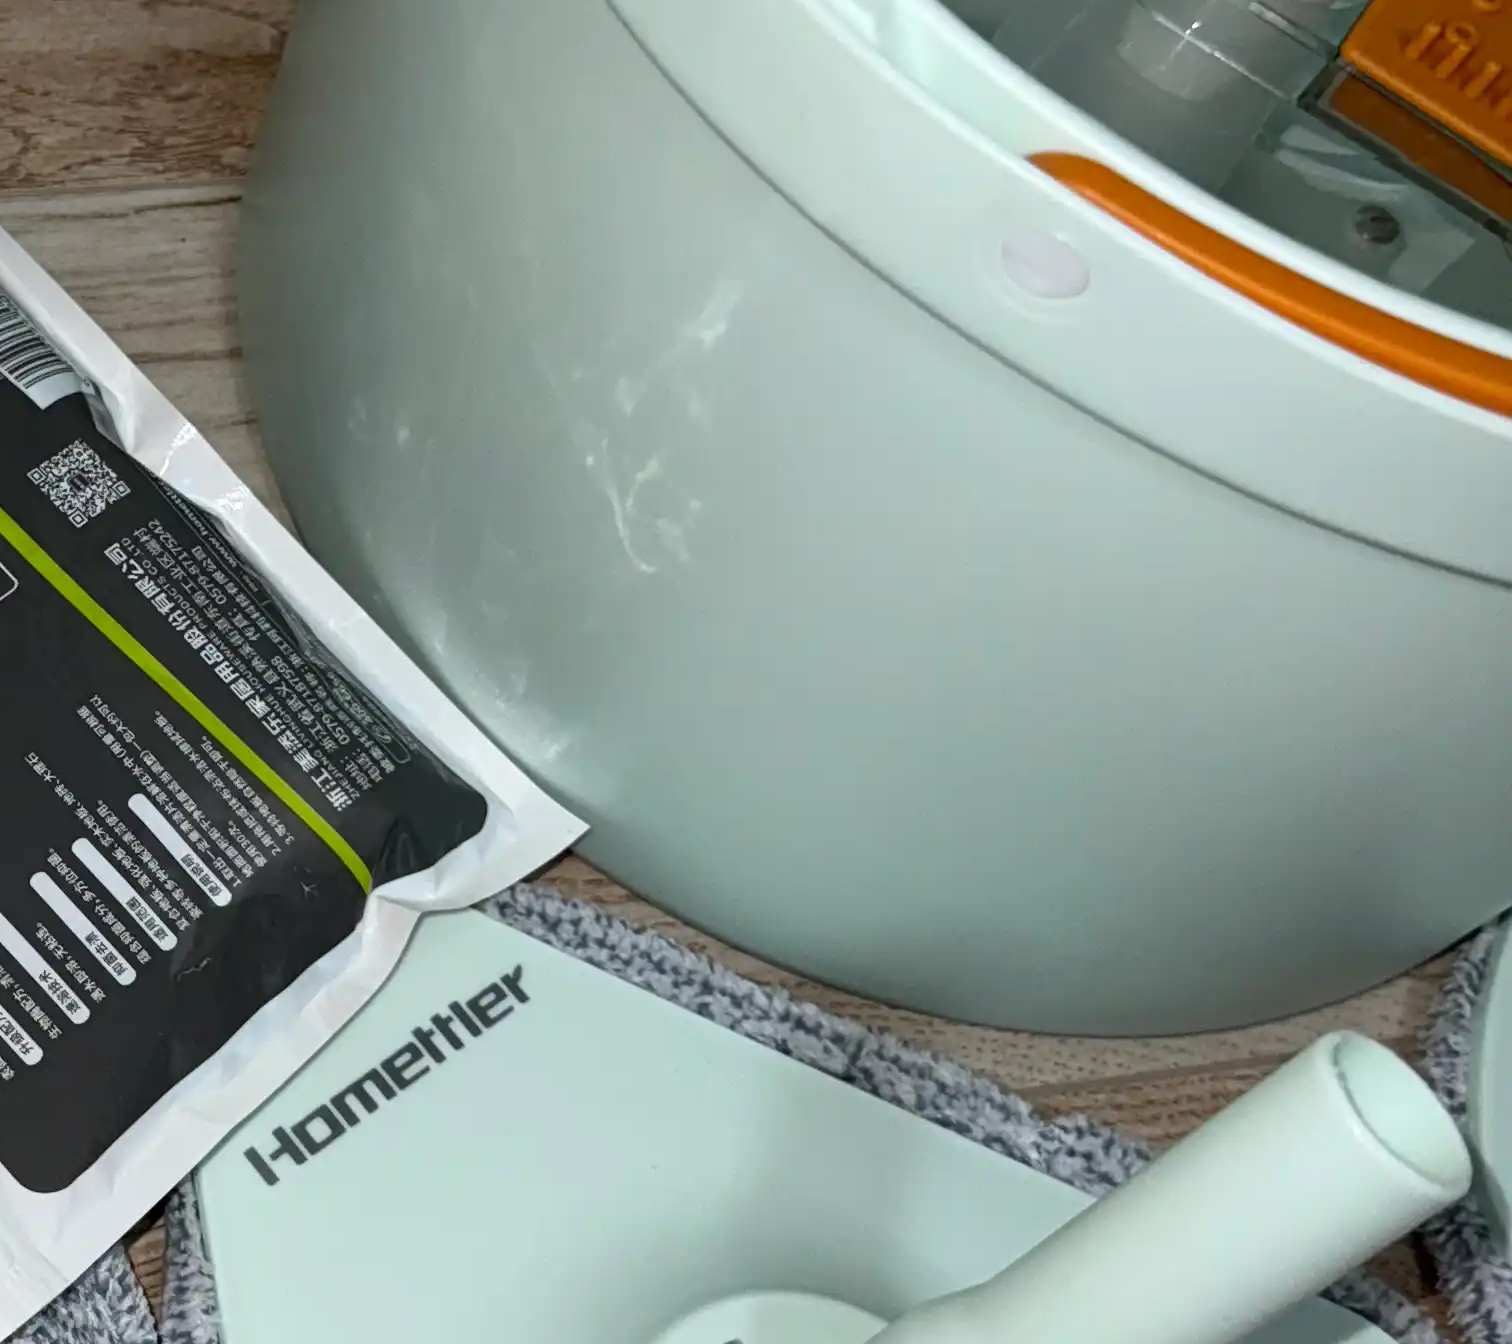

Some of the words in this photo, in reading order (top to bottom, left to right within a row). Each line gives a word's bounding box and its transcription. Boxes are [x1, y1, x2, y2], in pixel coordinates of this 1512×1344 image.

[148, 519, 227, 604] 0579-87175242
[104, 543, 352, 811] 浙江美添乐家居用品股份有限公司
[271, 656, 350, 744] 0579-87187598
[181, 854, 221, 896] 使用说明
[126, 897, 168, 941] 适用范围
[85, 931, 128, 976] 抑菌去渍
[39, 970, 80, 1014] 速溶技术
[243, 964, 531, 1186] Homettler
